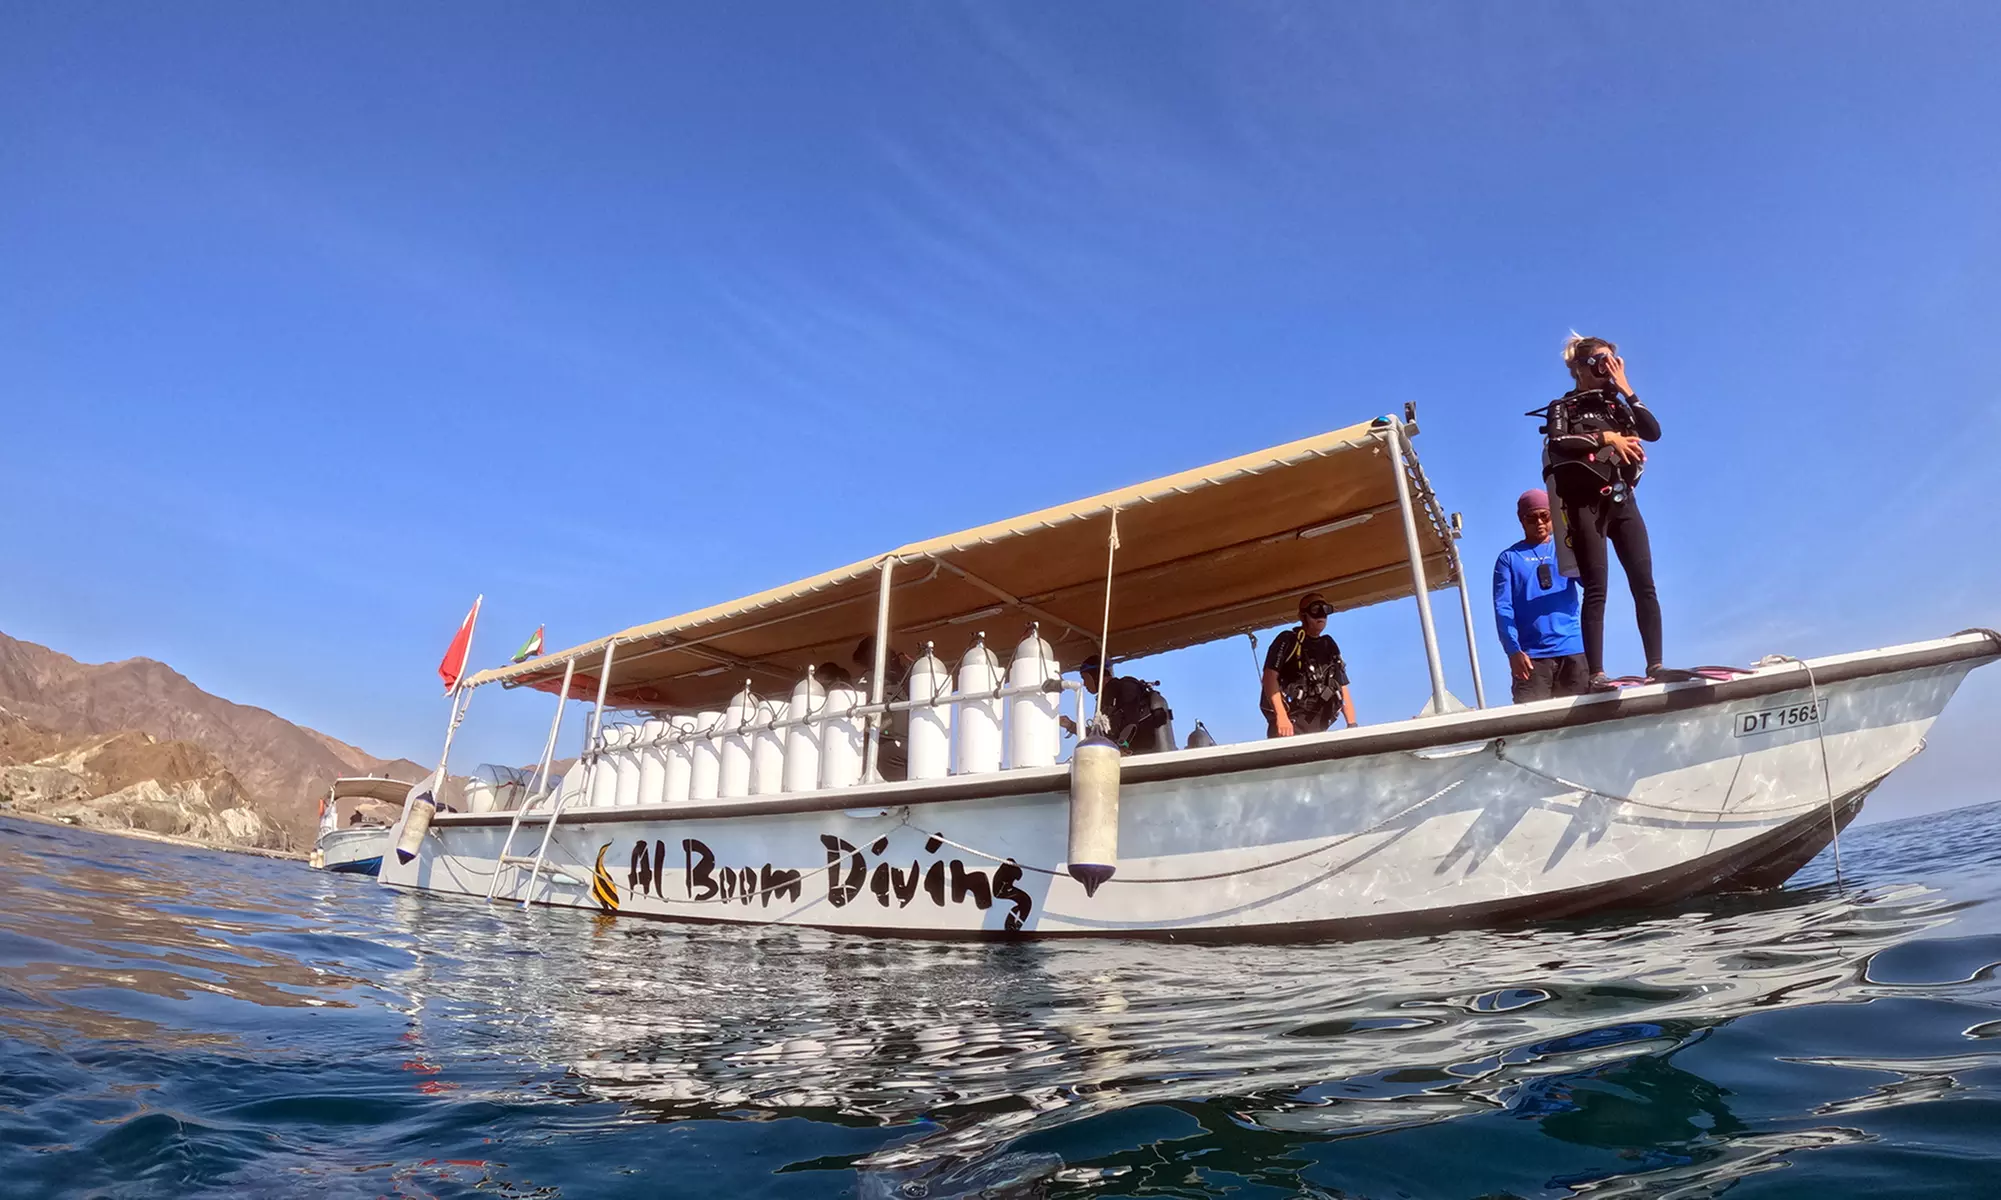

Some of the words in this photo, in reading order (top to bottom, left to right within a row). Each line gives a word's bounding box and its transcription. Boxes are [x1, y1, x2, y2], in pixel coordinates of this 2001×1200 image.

[1743, 712, 1771, 732] DT
[1778, 703, 1820, 726] 1565
[627, 839, 669, 903] Al
[682, 838, 802, 908] Boom
[820, 832, 1033, 931] Diving
